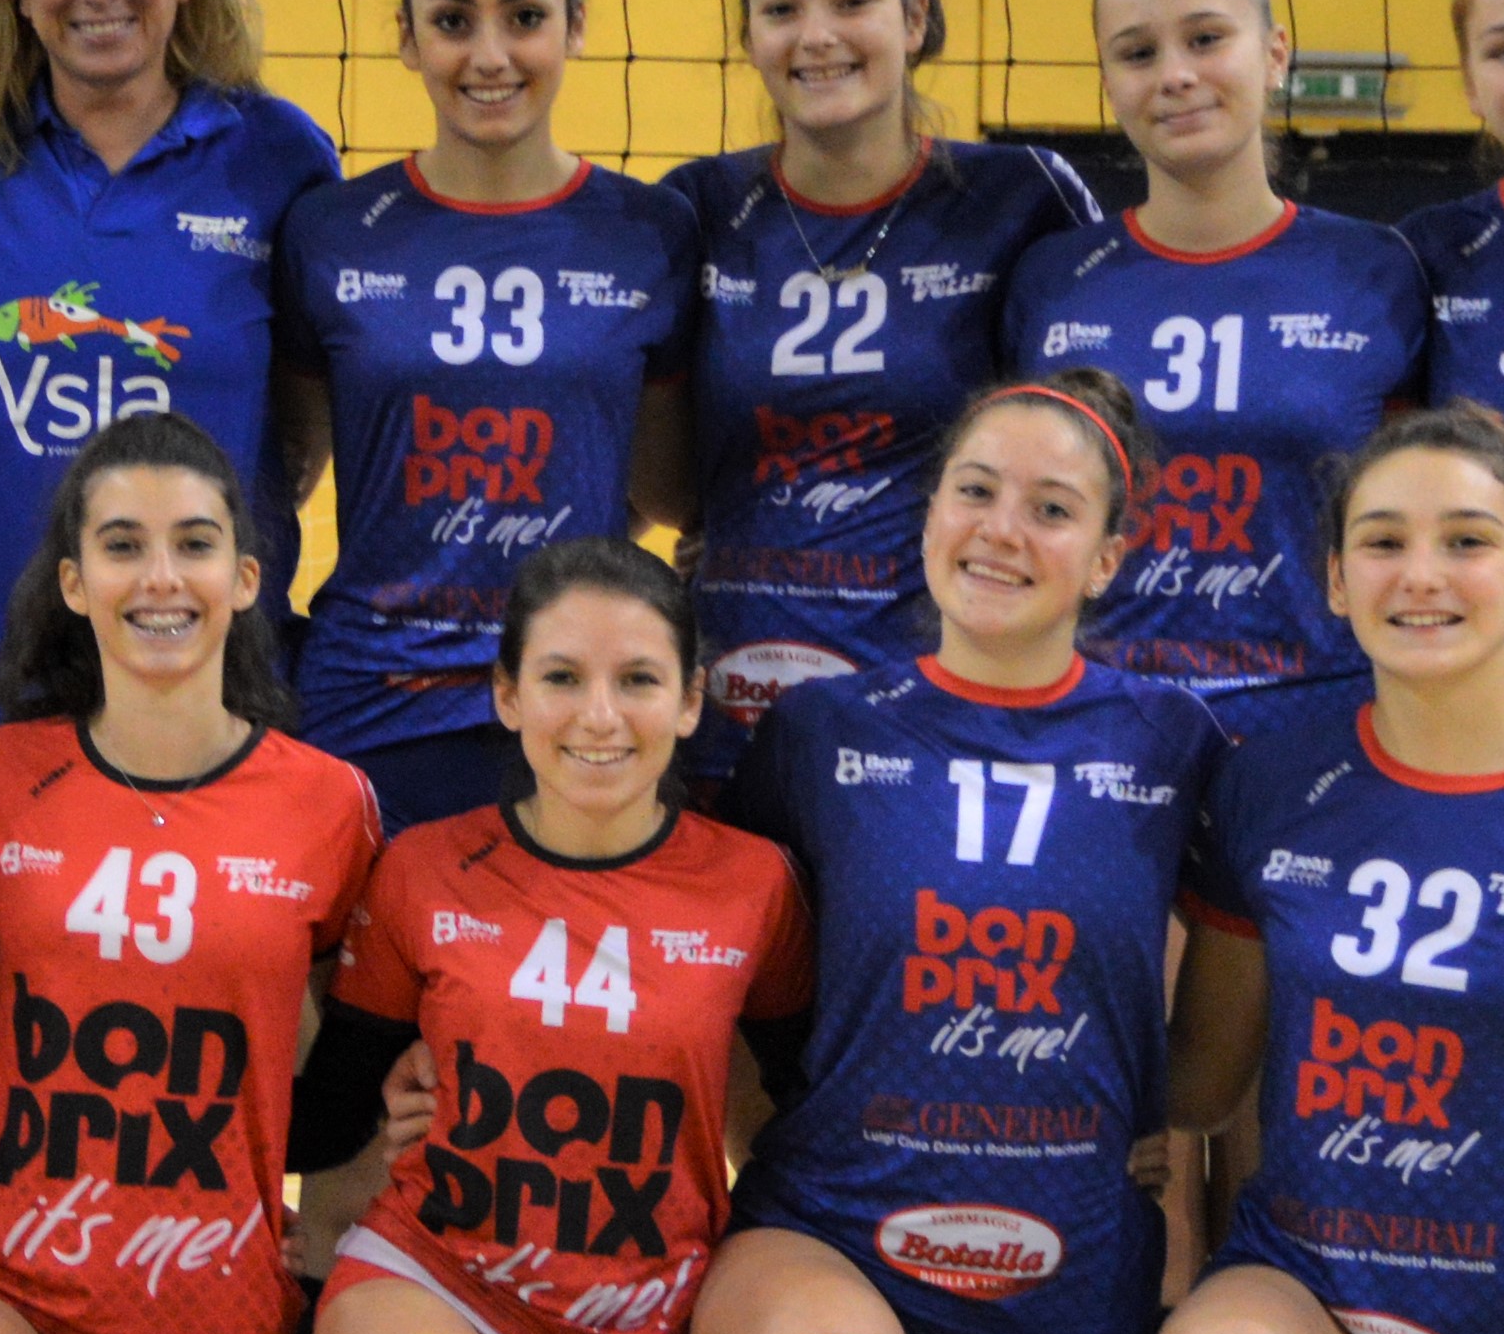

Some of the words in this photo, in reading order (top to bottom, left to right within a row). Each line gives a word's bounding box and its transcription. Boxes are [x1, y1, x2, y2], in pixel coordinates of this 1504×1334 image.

[432, 265, 545, 367] 33
[771, 271, 887, 375] 22
[1144, 315, 1243, 412] 31
[412, 395, 553, 457] bon
[404, 454, 548, 506] prix
[1135, 546, 1192, 597] it's
[1193, 553, 1284, 609] me!
[948, 758, 1046, 866] 17
[65, 846, 198, 964] 43
[915, 888, 1075, 962] bon
[1331, 859, 1482, 992] 32
[510, 917, 637, 1034] 44
[902, 955, 1063, 1015] prix
[12, 972, 248, 1098] bon
[930, 1003, 993, 1057] it's
[995, 1012, 1087, 1073] me!
[1310, 998, 1464, 1077] bon
[448, 1039, 686, 1165] bon
[919, 1101, 1101, 1143] GENERALI
[1296, 1060, 1449, 1128] prix
[1319, 1115, 1381, 1161] it's
[1384, 1132, 1481, 1184] me!
[2, 1175, 113, 1267] it's
[116, 1198, 263, 1298] me!
[417, 1142, 672, 1258] prix
[1305, 1205, 1500, 1259] GENERALI
[895, 1230, 1046, 1273] Botalla
